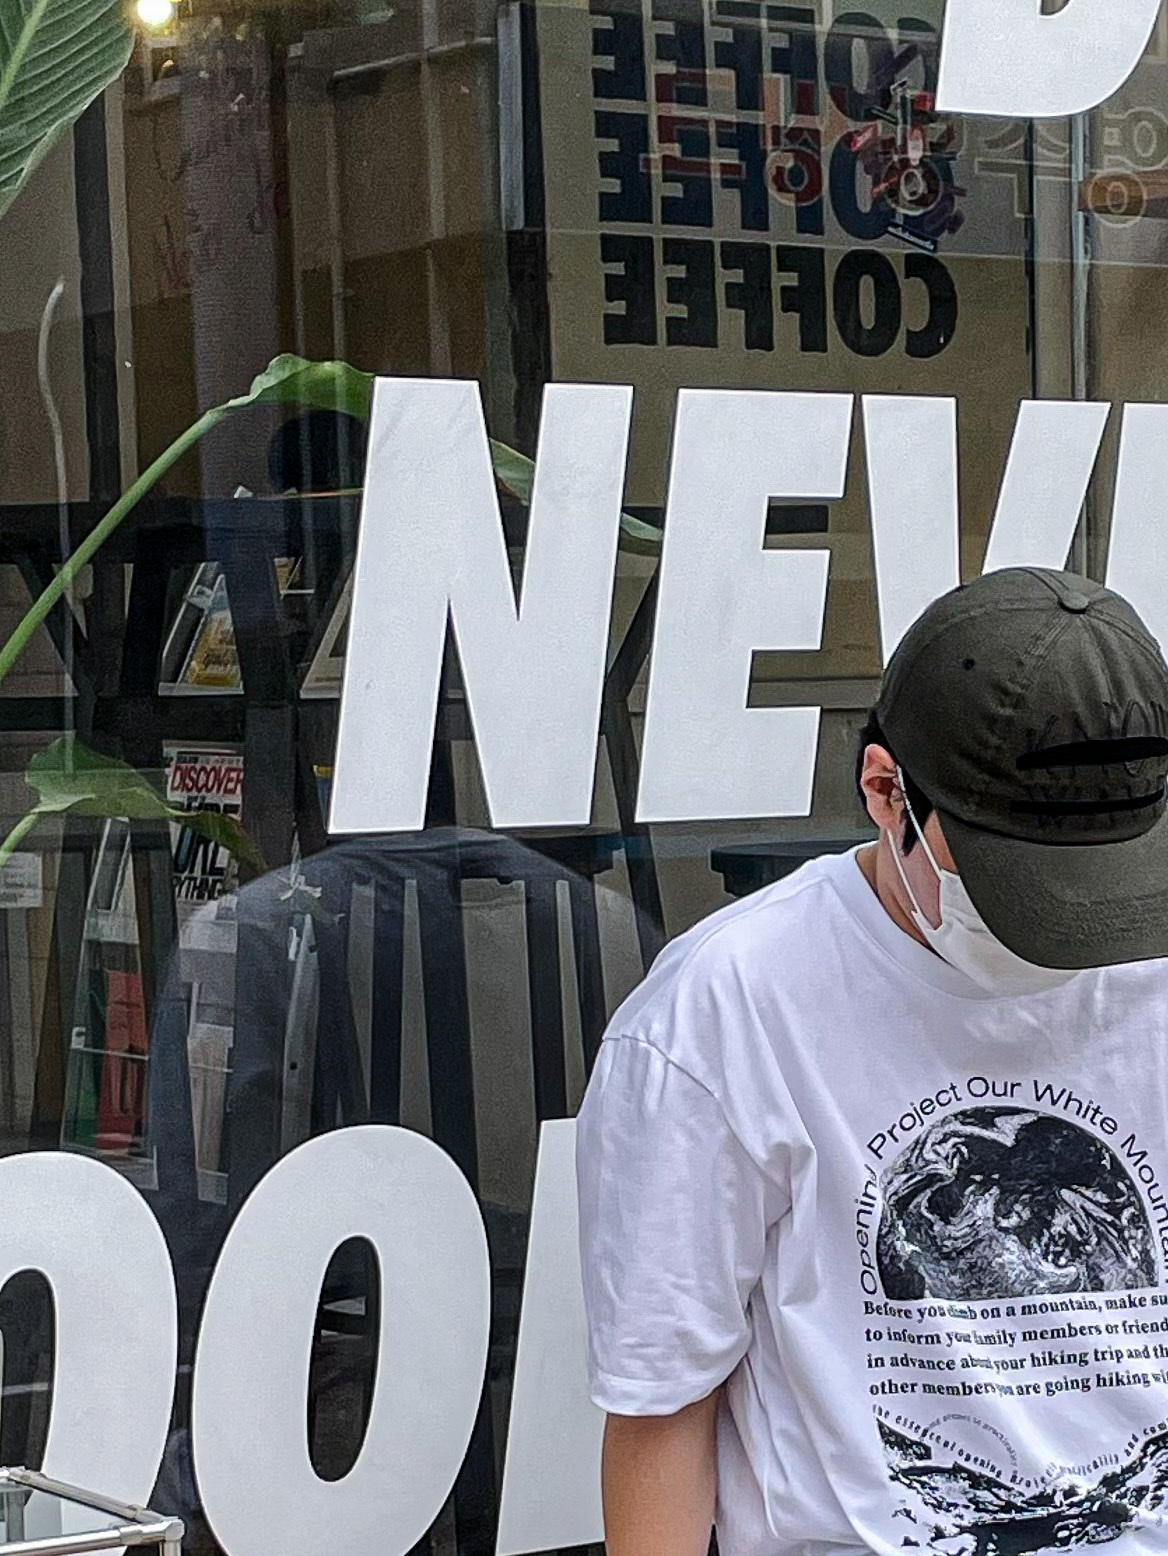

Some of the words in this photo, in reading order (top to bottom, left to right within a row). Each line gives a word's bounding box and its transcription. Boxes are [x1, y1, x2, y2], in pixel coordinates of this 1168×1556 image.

[867, 1082, 963, 1160] Project
[966, 1076, 1022, 1098] Our
[1033, 1080, 1118, 1135] White
[864, 1300, 913, 1319] Before
[981, 1306, 1001, 1320] on
[1006, 1305, 1017, 1317] a
[1021, 1295, 1103, 1316] mountain,
[1105, 1293, 1147, 1310] make
[865, 1327, 883, 1342] to
[887, 1326, 942, 1345] inform
[1022, 1321, 1102, 1342] members
[867, 1352, 885, 1369] in
[889, 1352, 956, 1371] advance
[1030, 1350, 1090, 1368] hiking
[1094, 1344, 1124, 1363] trip
[1127, 1344, 1150, 1359] and
[869, 1378, 918, 1396] other
[1016, 1382, 1041, 1396] are
[1045, 1375, 1091, 1397] going
[1095, 1370, 1150, 1388] hiking
